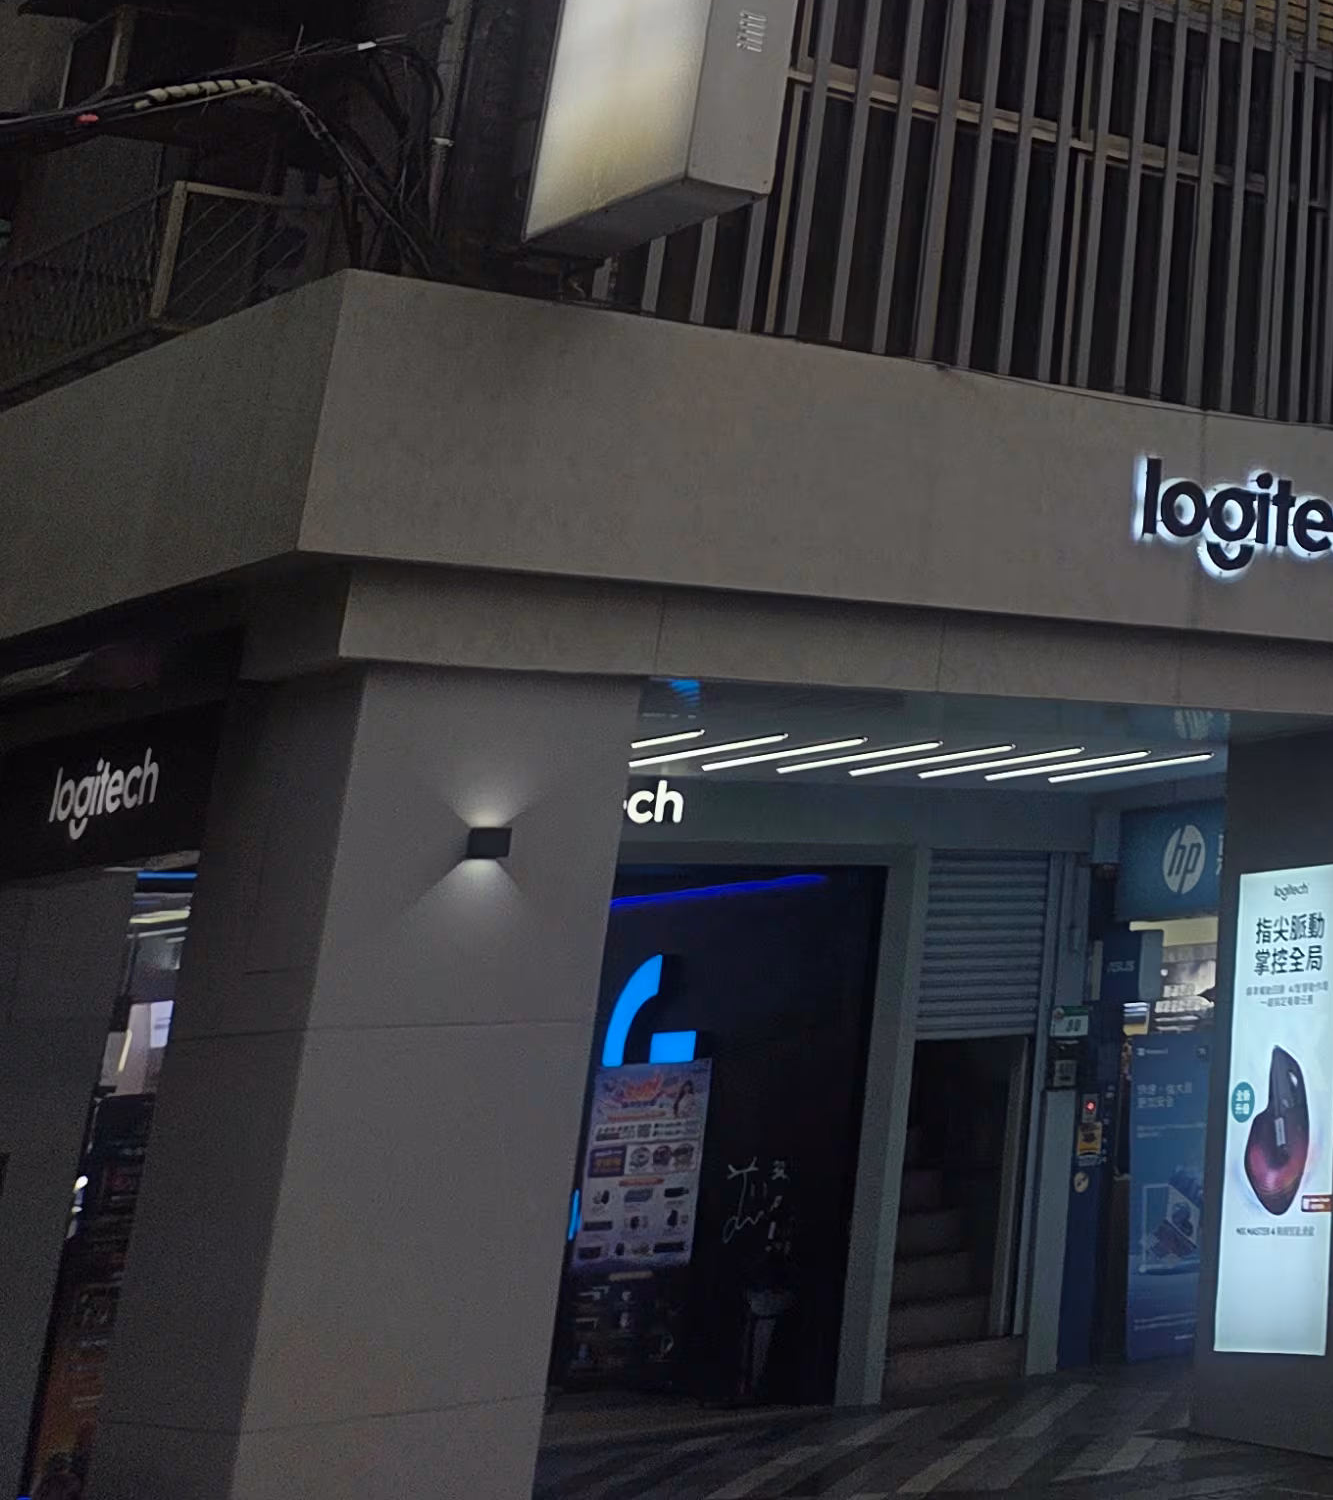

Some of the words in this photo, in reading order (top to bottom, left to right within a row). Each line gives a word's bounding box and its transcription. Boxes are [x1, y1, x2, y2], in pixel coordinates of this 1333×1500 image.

[48, 746, 160, 841] logitech
[1164, 825, 1205, 894] hp
[1273, 881, 1309, 902] logitech
[1255, 911, 1325, 944] 指尖脈動
[1254, 945, 1324, 976] 掌控全局
